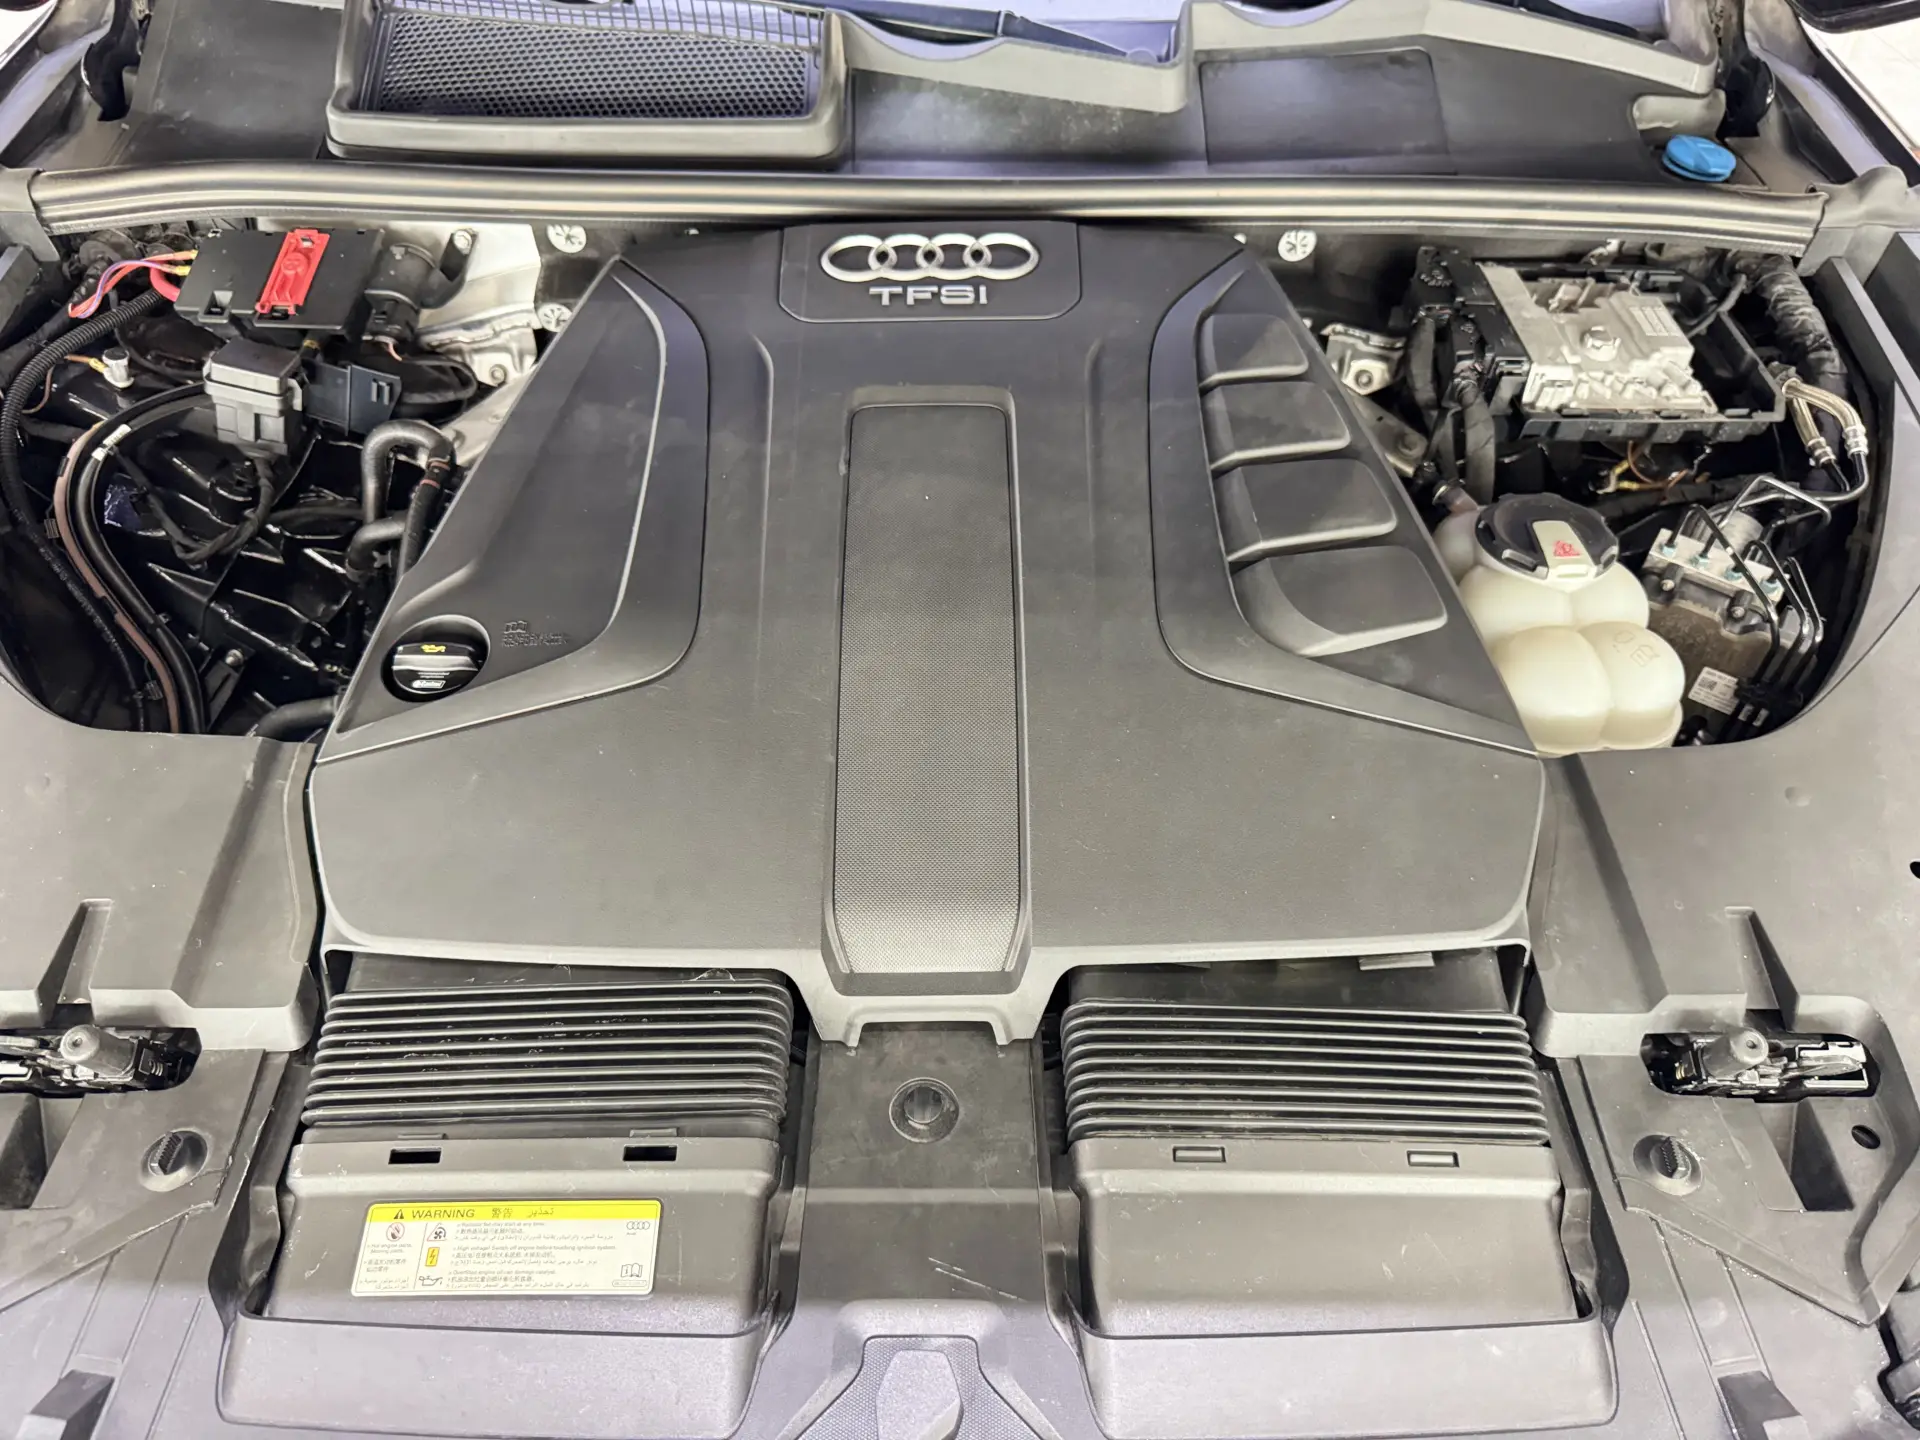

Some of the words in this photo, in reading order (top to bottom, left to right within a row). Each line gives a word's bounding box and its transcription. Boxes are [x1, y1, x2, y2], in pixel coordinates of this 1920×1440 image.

[869, 285, 988, 306] TFSI
[411, 1209, 475, 1219] WARNING
[491, 1207, 513, 1219] 警告
